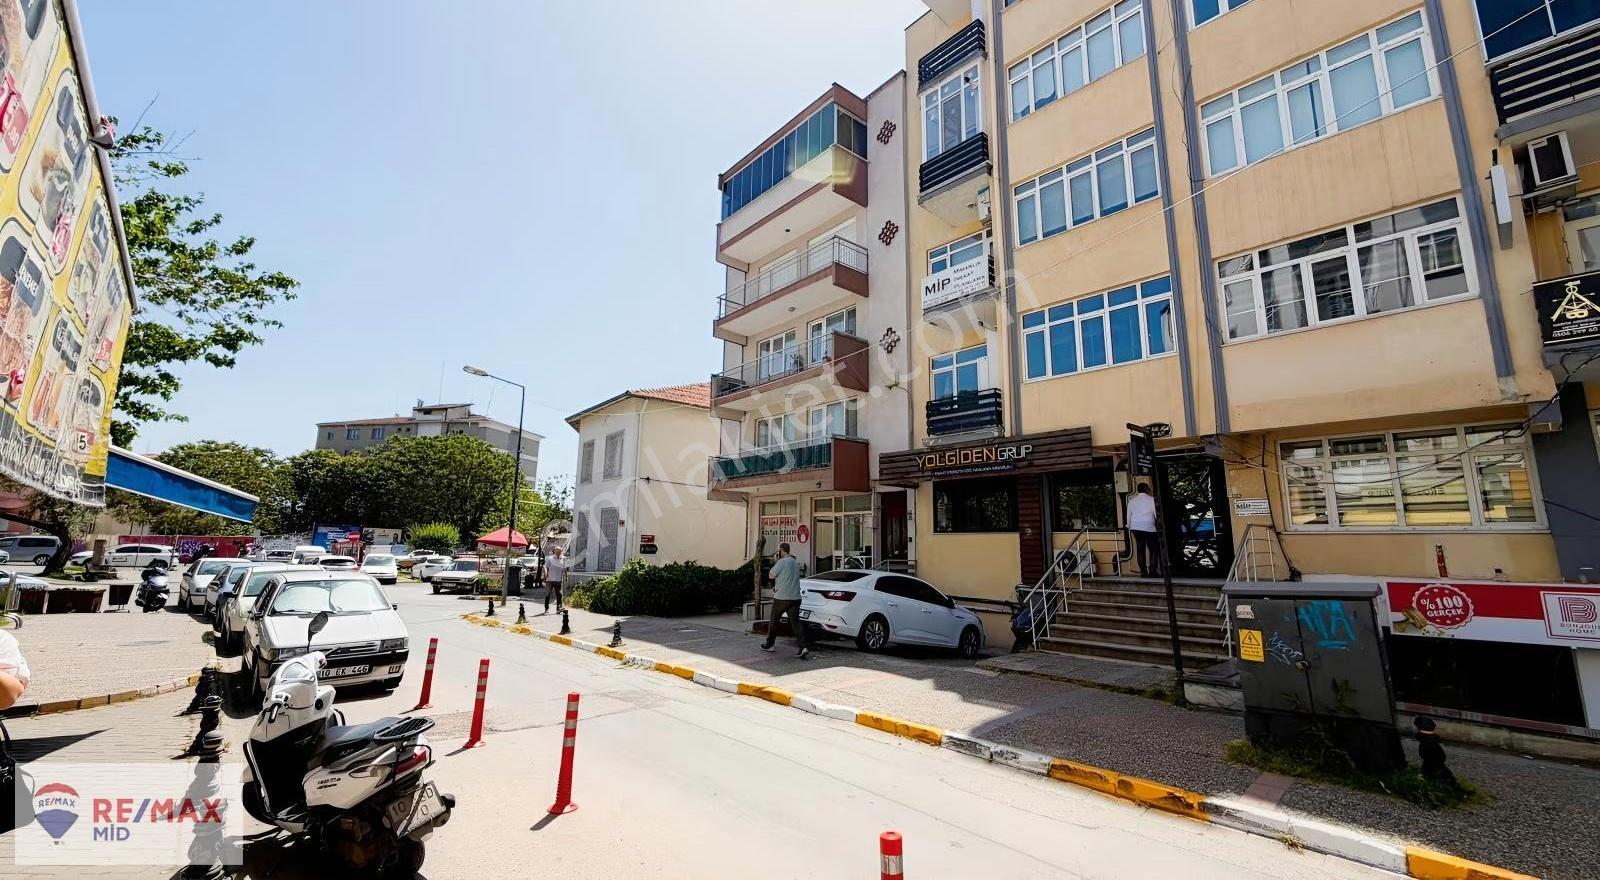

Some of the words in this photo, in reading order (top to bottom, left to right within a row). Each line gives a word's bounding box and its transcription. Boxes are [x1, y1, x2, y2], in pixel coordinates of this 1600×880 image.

[925, 278, 951, 296] MİP
[997, 444, 1033, 460] GRUP
[1427, 608, 1465, 618] GERÇEK
